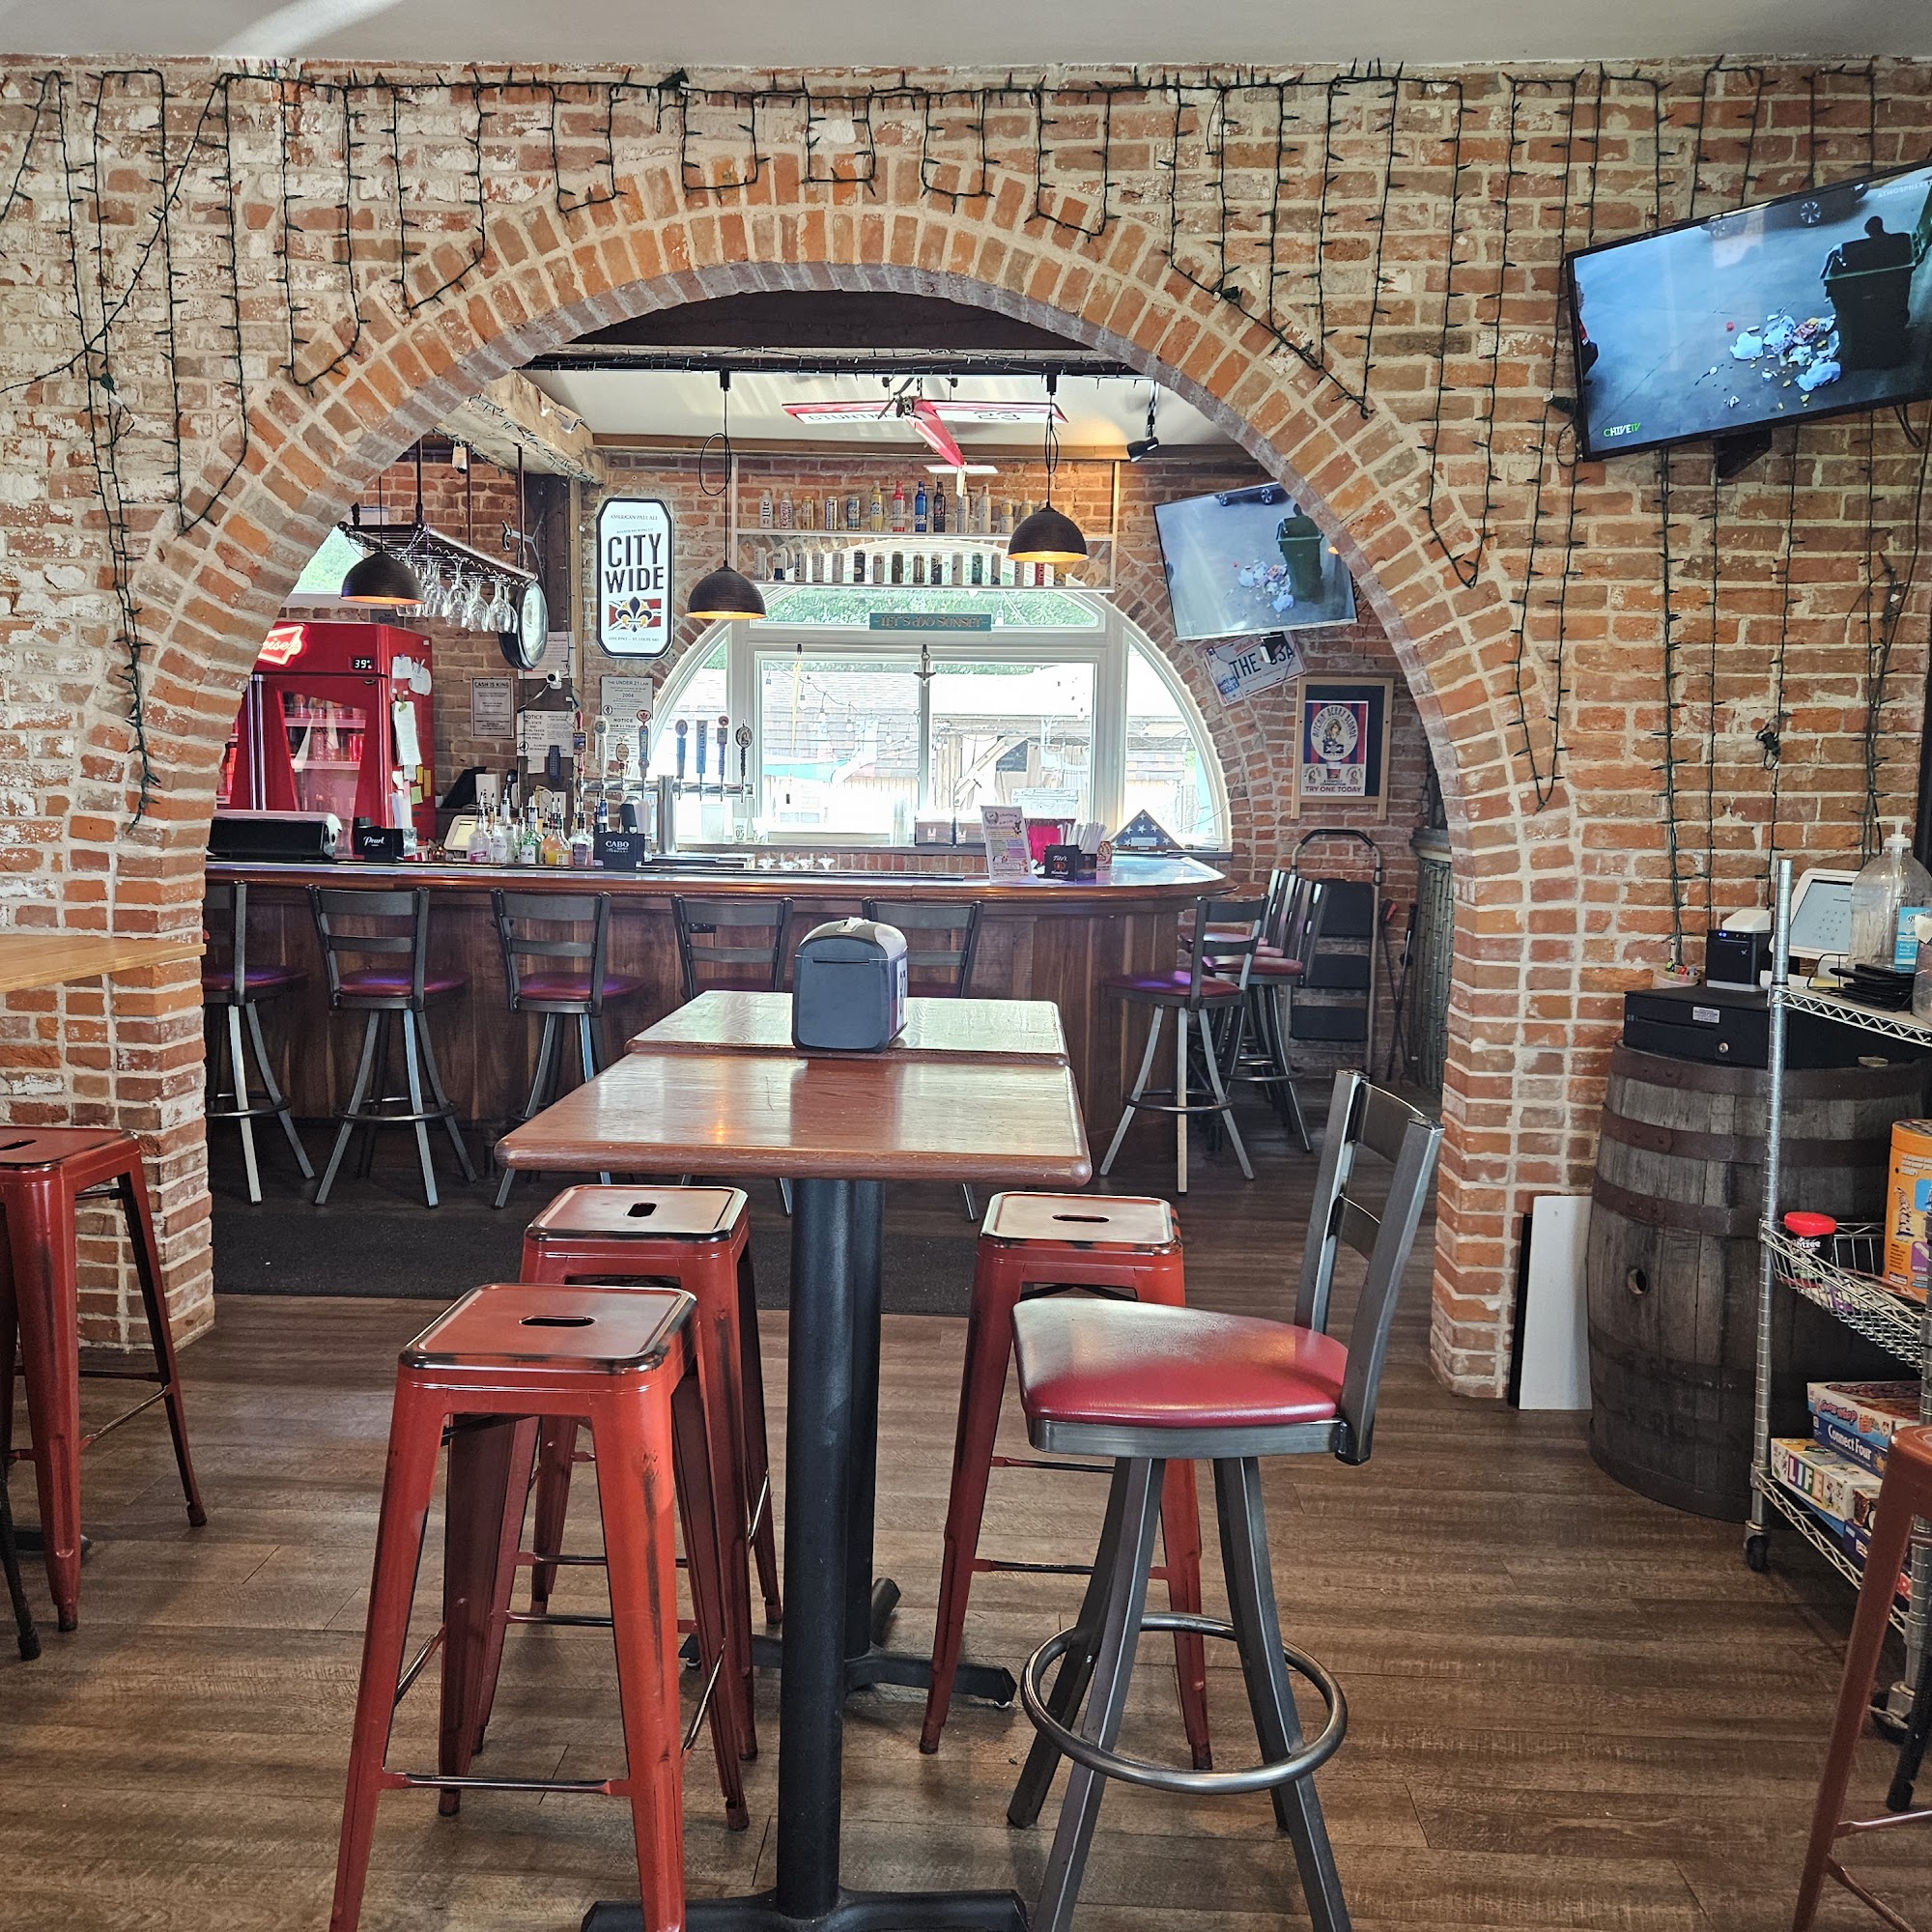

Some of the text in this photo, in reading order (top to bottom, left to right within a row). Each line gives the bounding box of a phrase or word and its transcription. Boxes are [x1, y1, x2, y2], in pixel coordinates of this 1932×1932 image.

[780, 501, 788, 527] Coors
[608, 532, 662, 568] CITY
[605, 566, 664, 593] WIDE
[1229, 652, 1262, 679] THE
[362, 836, 384, 846] Pearl
[1828, 1424, 1872, 1461] Connect Four
[1788, 1455, 1824, 1502] LIFE
